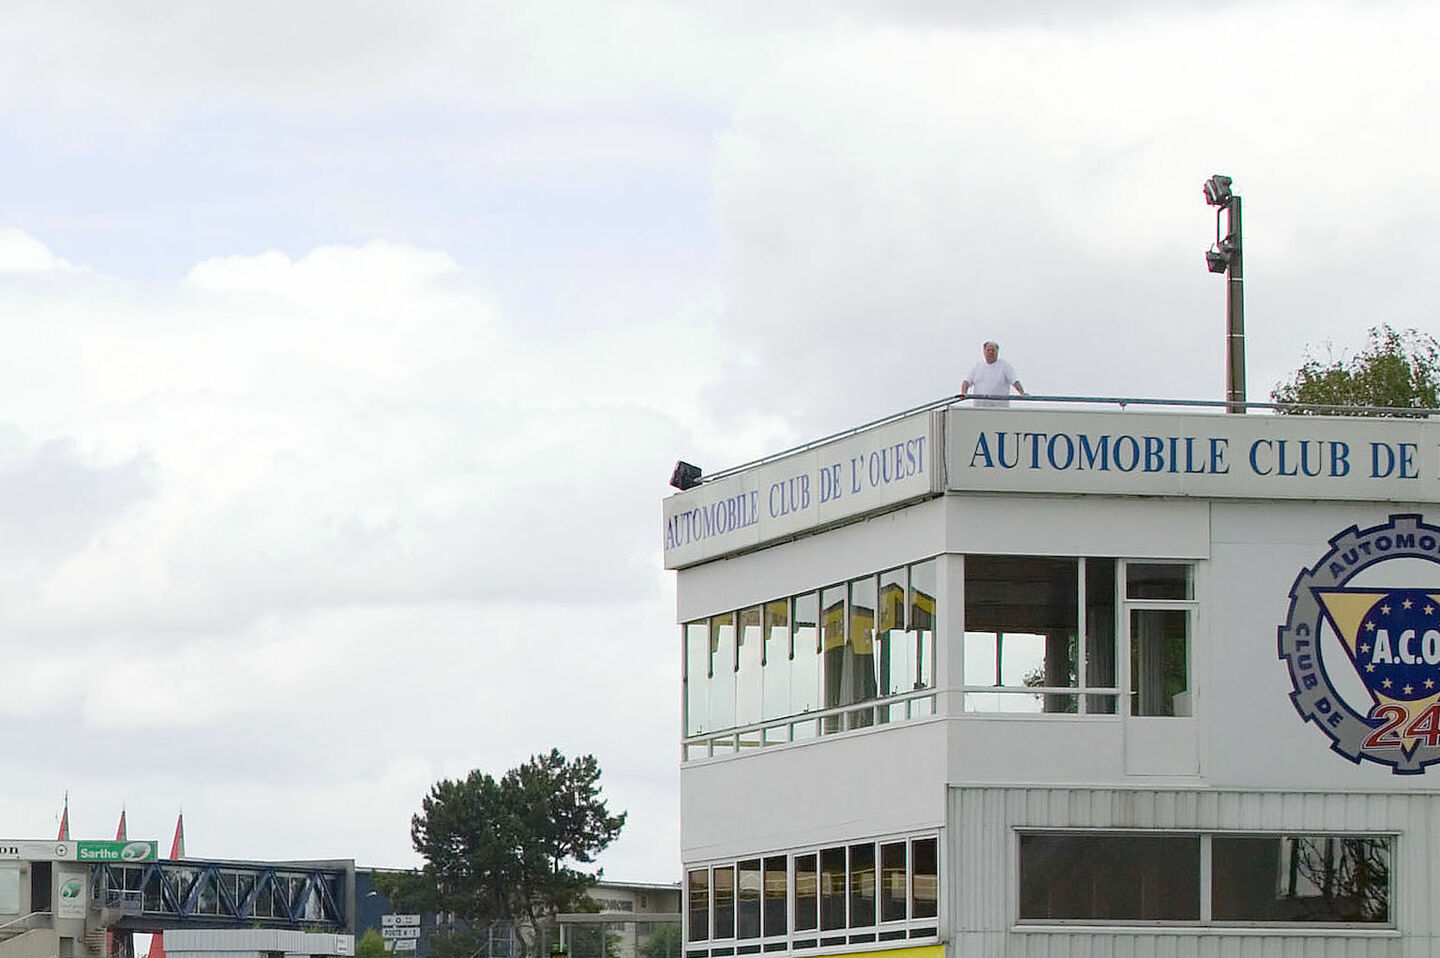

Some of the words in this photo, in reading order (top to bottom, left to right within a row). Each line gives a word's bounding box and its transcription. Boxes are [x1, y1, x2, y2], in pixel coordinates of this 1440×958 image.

[970, 431, 1230, 476] AUTOMOBILE
[1249, 439, 1351, 478] CLUB
[1369, 442, 1420, 479] DE
[666, 490, 759, 550] AUTOMOBILE
[769, 474, 810, 519] CLUB
[820, 463, 842, 504] DE
[1329, 534, 1440, 579] AUTOMO
[1295, 622, 1318, 692] CLUB
[1314, 696, 1344, 729] DE
[1361, 703, 1440, 751] 24
[80, 848, 119, 860] Sarthe
